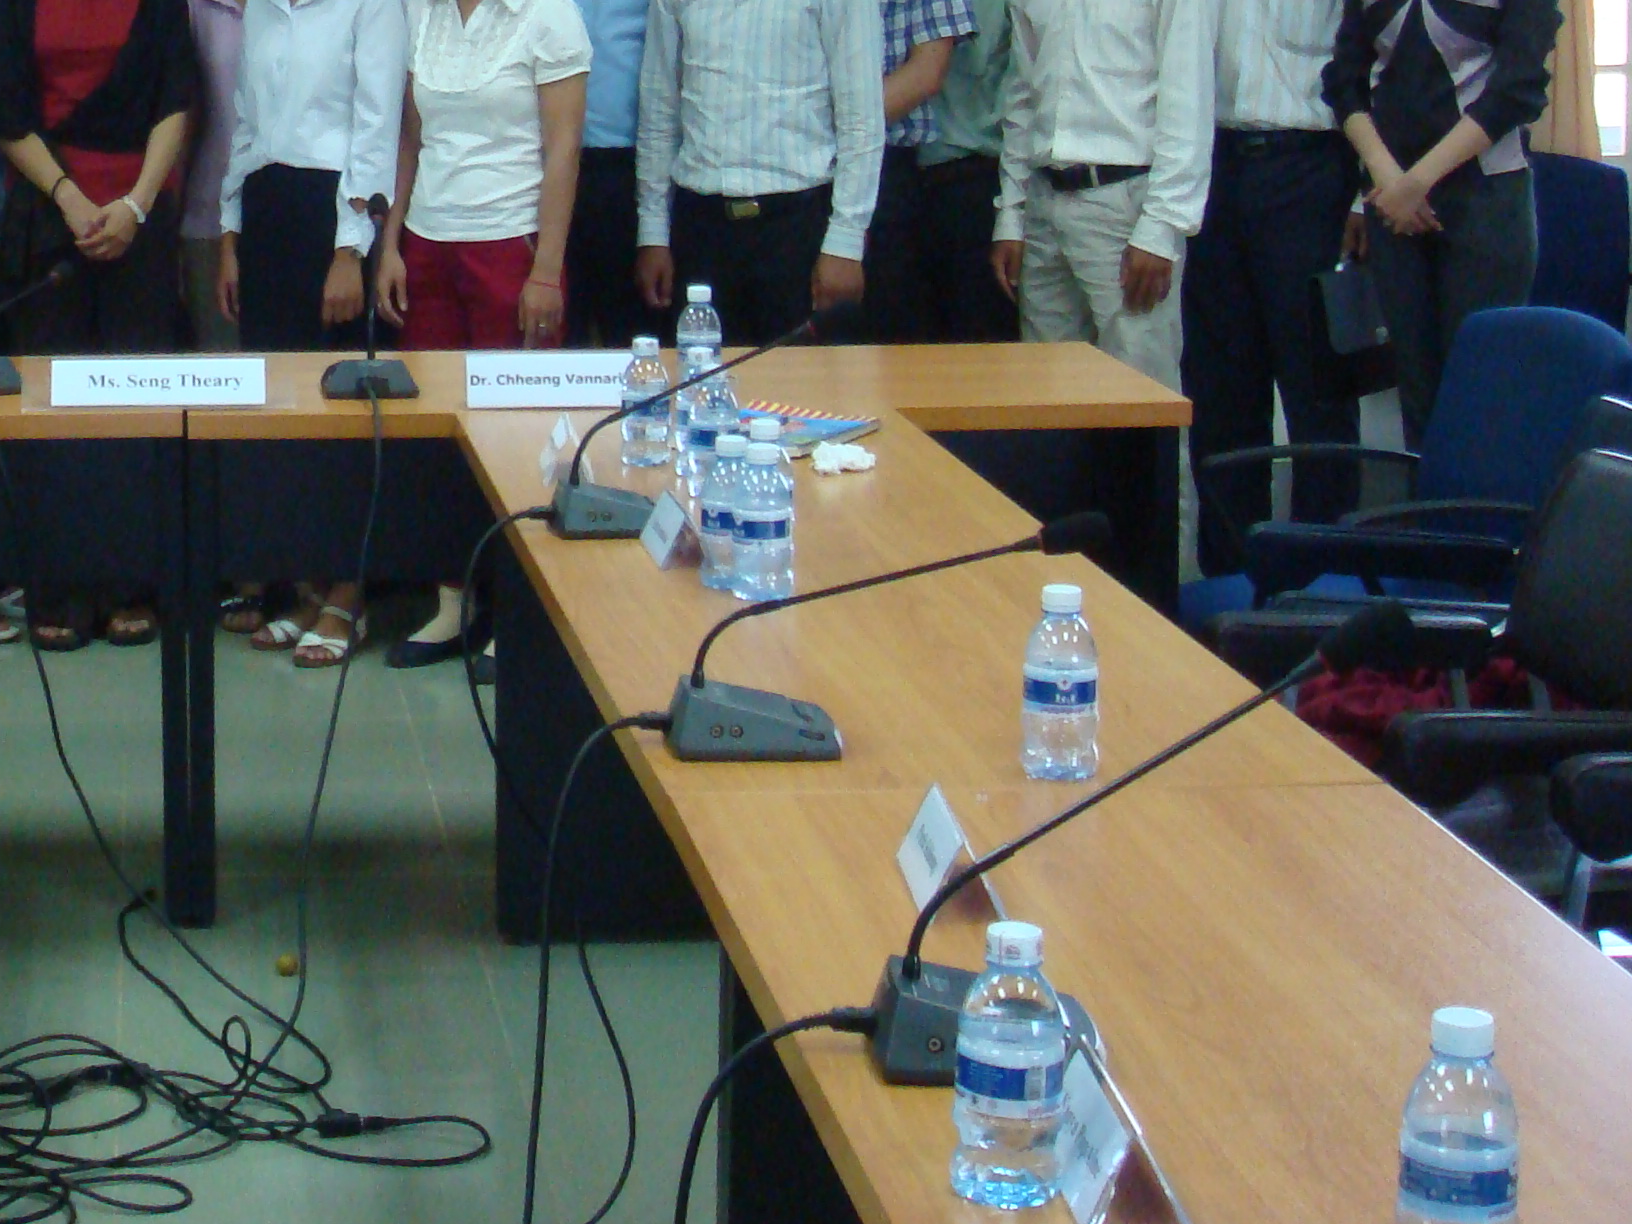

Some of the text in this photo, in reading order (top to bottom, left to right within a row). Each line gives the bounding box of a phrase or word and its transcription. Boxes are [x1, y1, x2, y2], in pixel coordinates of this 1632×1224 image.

[88, 373, 244, 391] Ms. Seng Theary
[470, 372, 627, 389] Dr. Chheang Vannari
